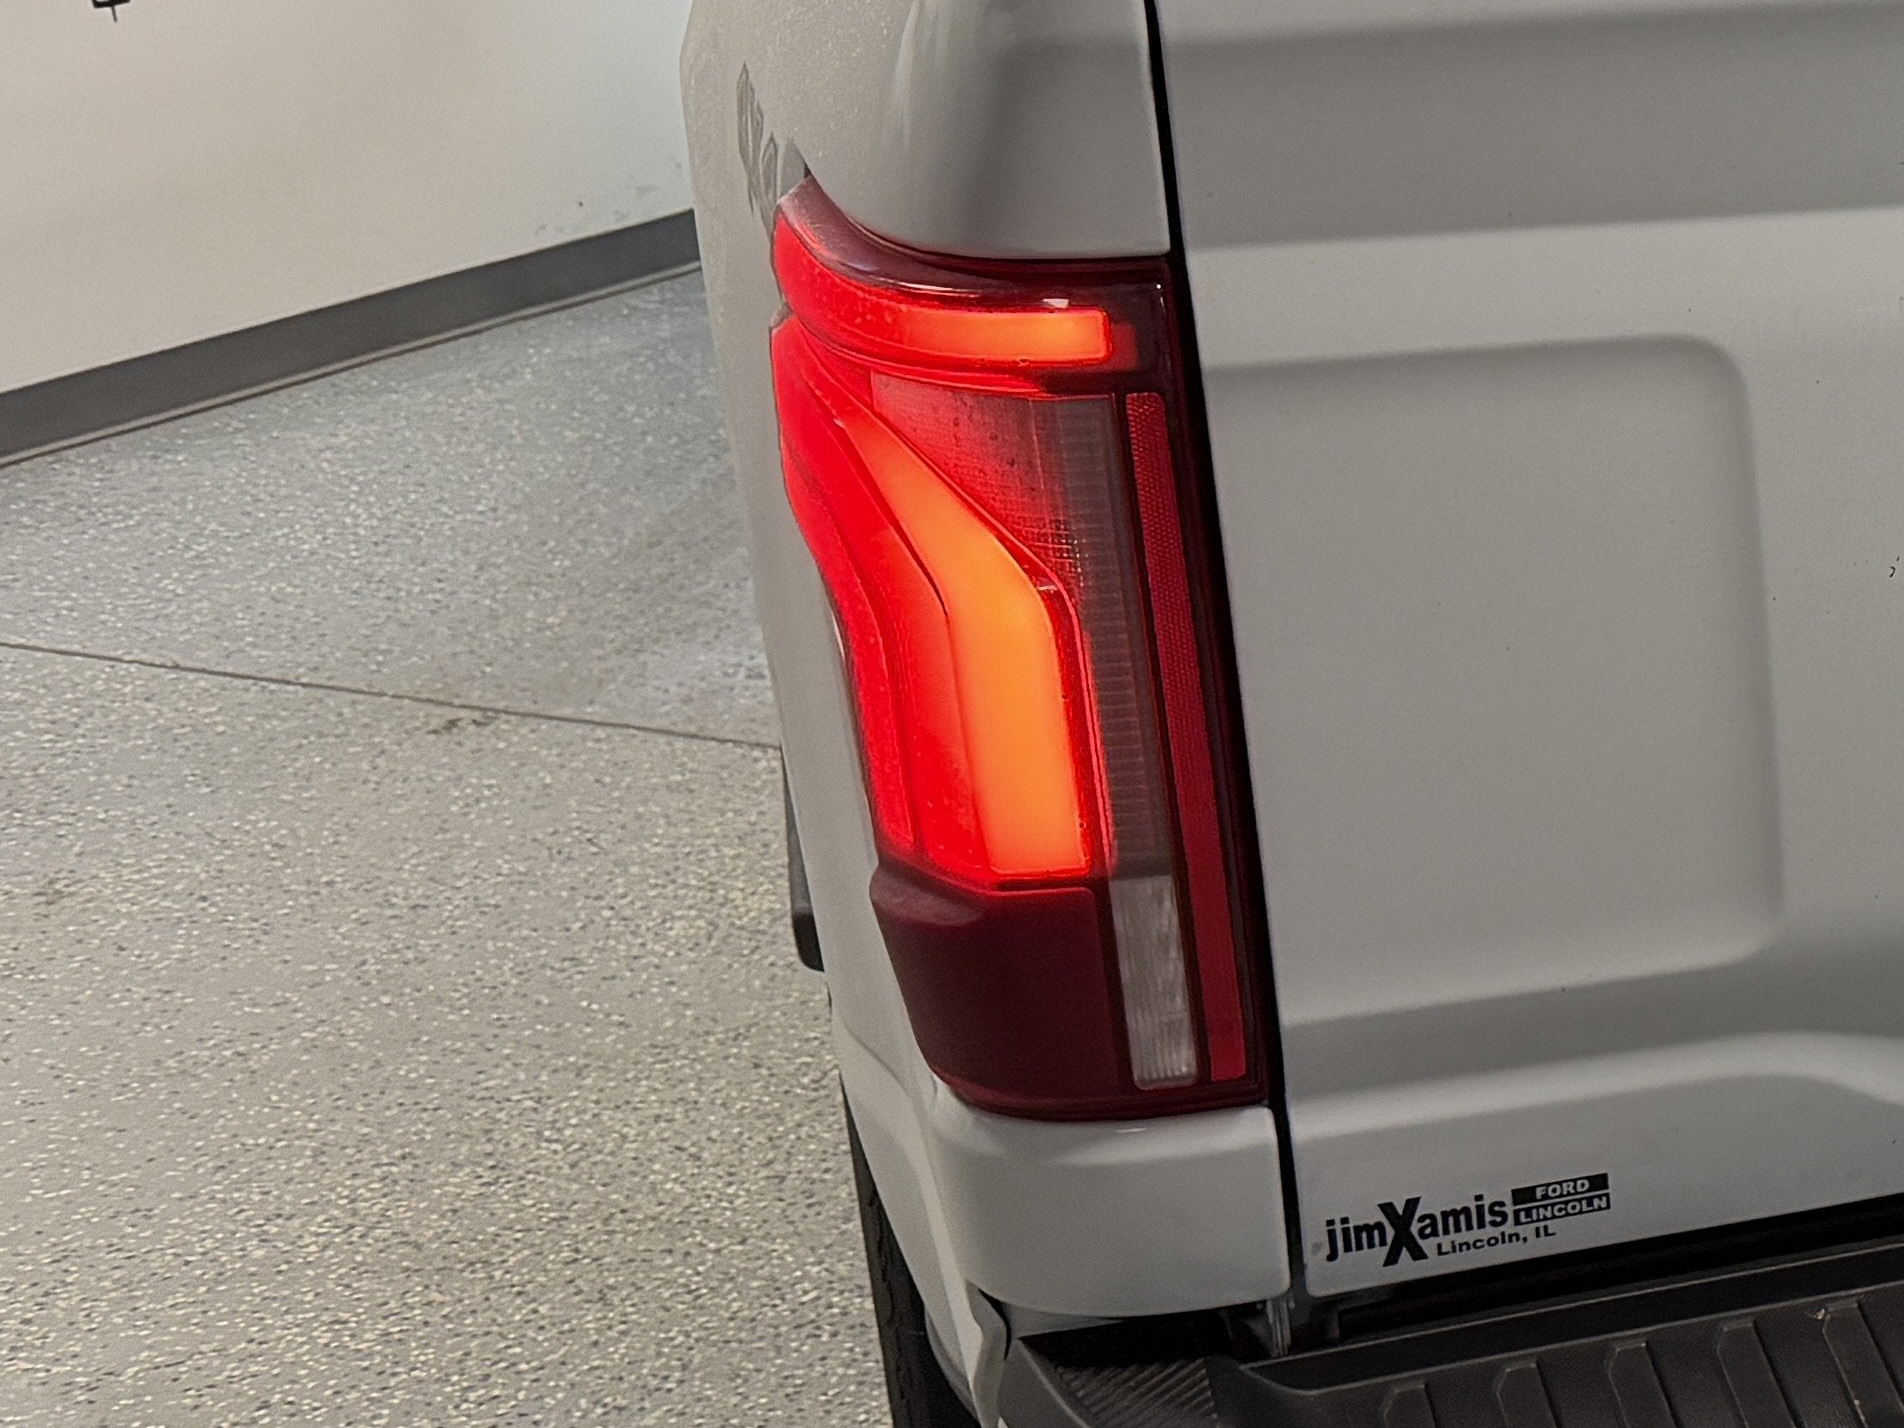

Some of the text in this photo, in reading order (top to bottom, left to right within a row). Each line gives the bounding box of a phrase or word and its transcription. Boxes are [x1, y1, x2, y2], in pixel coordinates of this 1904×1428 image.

[1535, 1178, 1590, 1200] FORD
[1518, 1196, 1608, 1223] LINCOLN
[1325, 1194, 1509, 1267] jimXamis
[1436, 1225, 1557, 1257] Lincoln, IL
